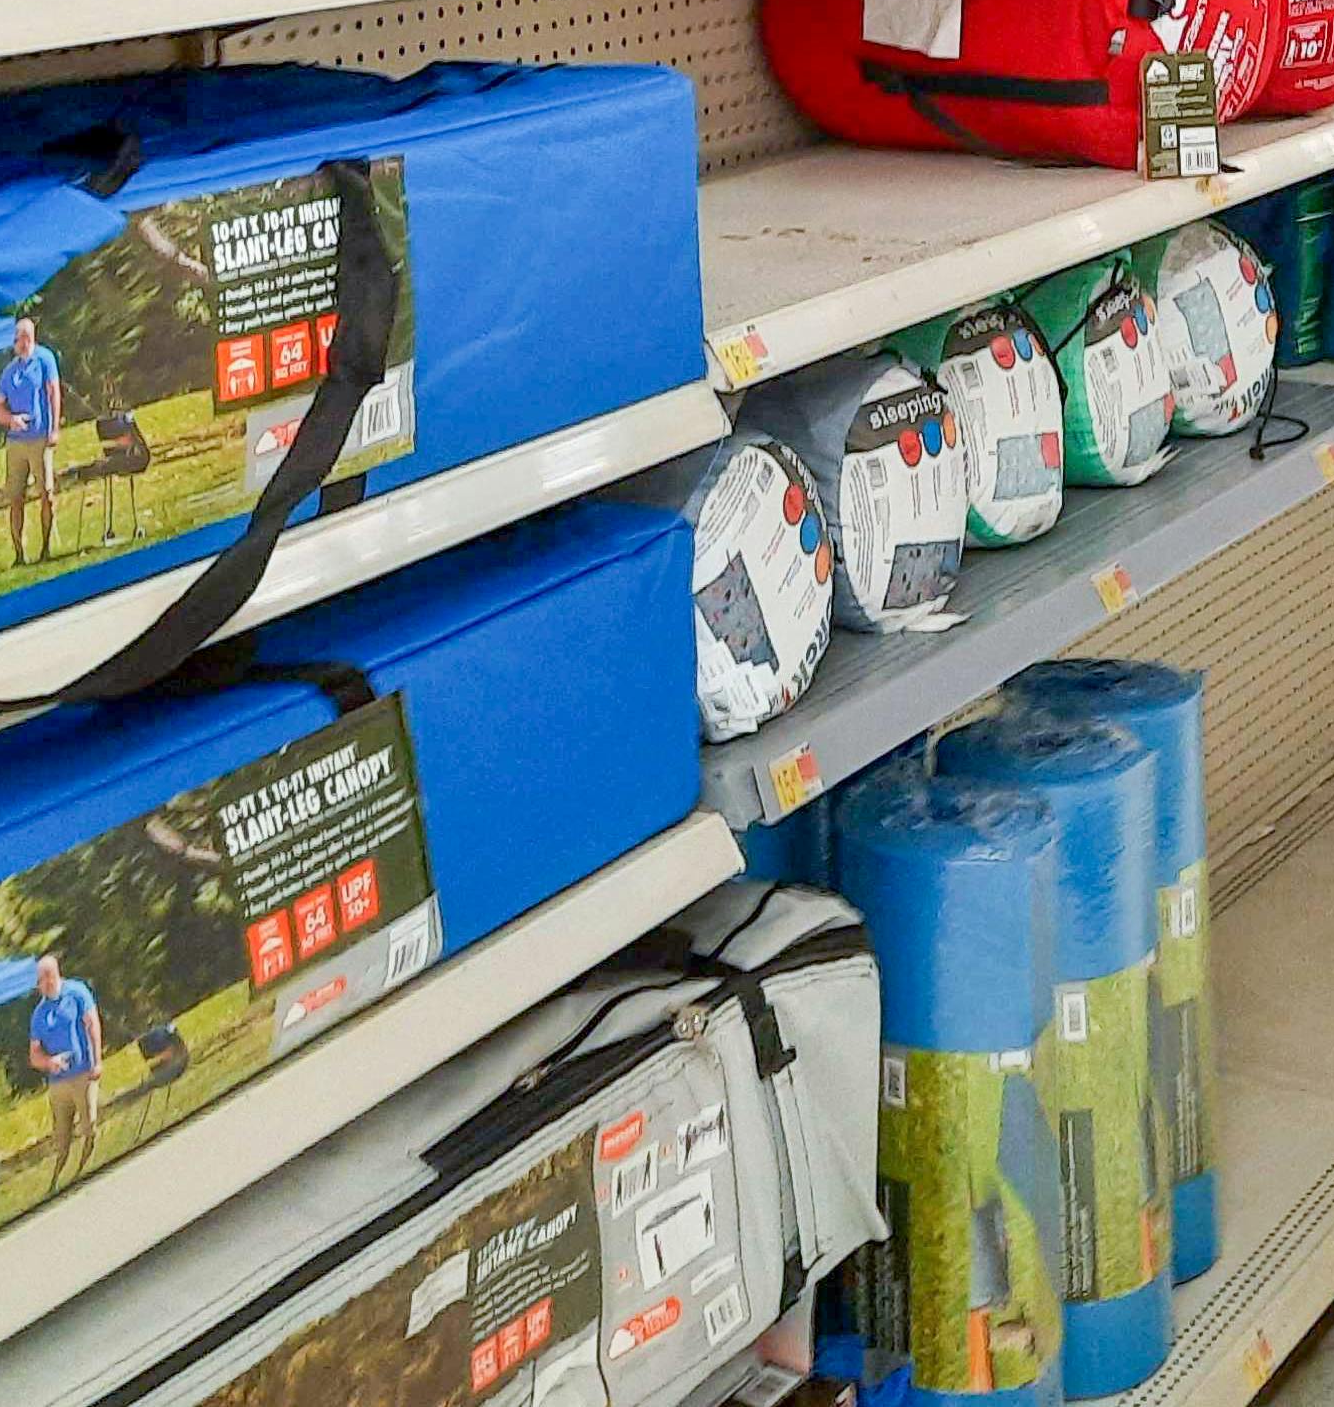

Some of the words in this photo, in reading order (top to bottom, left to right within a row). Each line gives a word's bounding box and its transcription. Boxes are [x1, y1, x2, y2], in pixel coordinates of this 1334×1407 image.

[211, 217, 248, 244] 10-FT
[263, 207, 295, 232] 10-FT
[213, 226, 308, 274] SLANT-LEG
[280, 340, 304, 366] 64
[868, 392, 942, 431] sleeping
[219, 794, 257, 828] 10-FT
[272, 770, 305, 803] 10-FT
[306, 742, 358, 785] INSTANT
[225, 787, 321, 857] SLANT-LEG
[324, 744, 393, 805] CANOPY
[341, 871, 372, 904] UPF
[305, 905, 327, 933] 64
[527, 1201, 579, 1250] CANOPY
